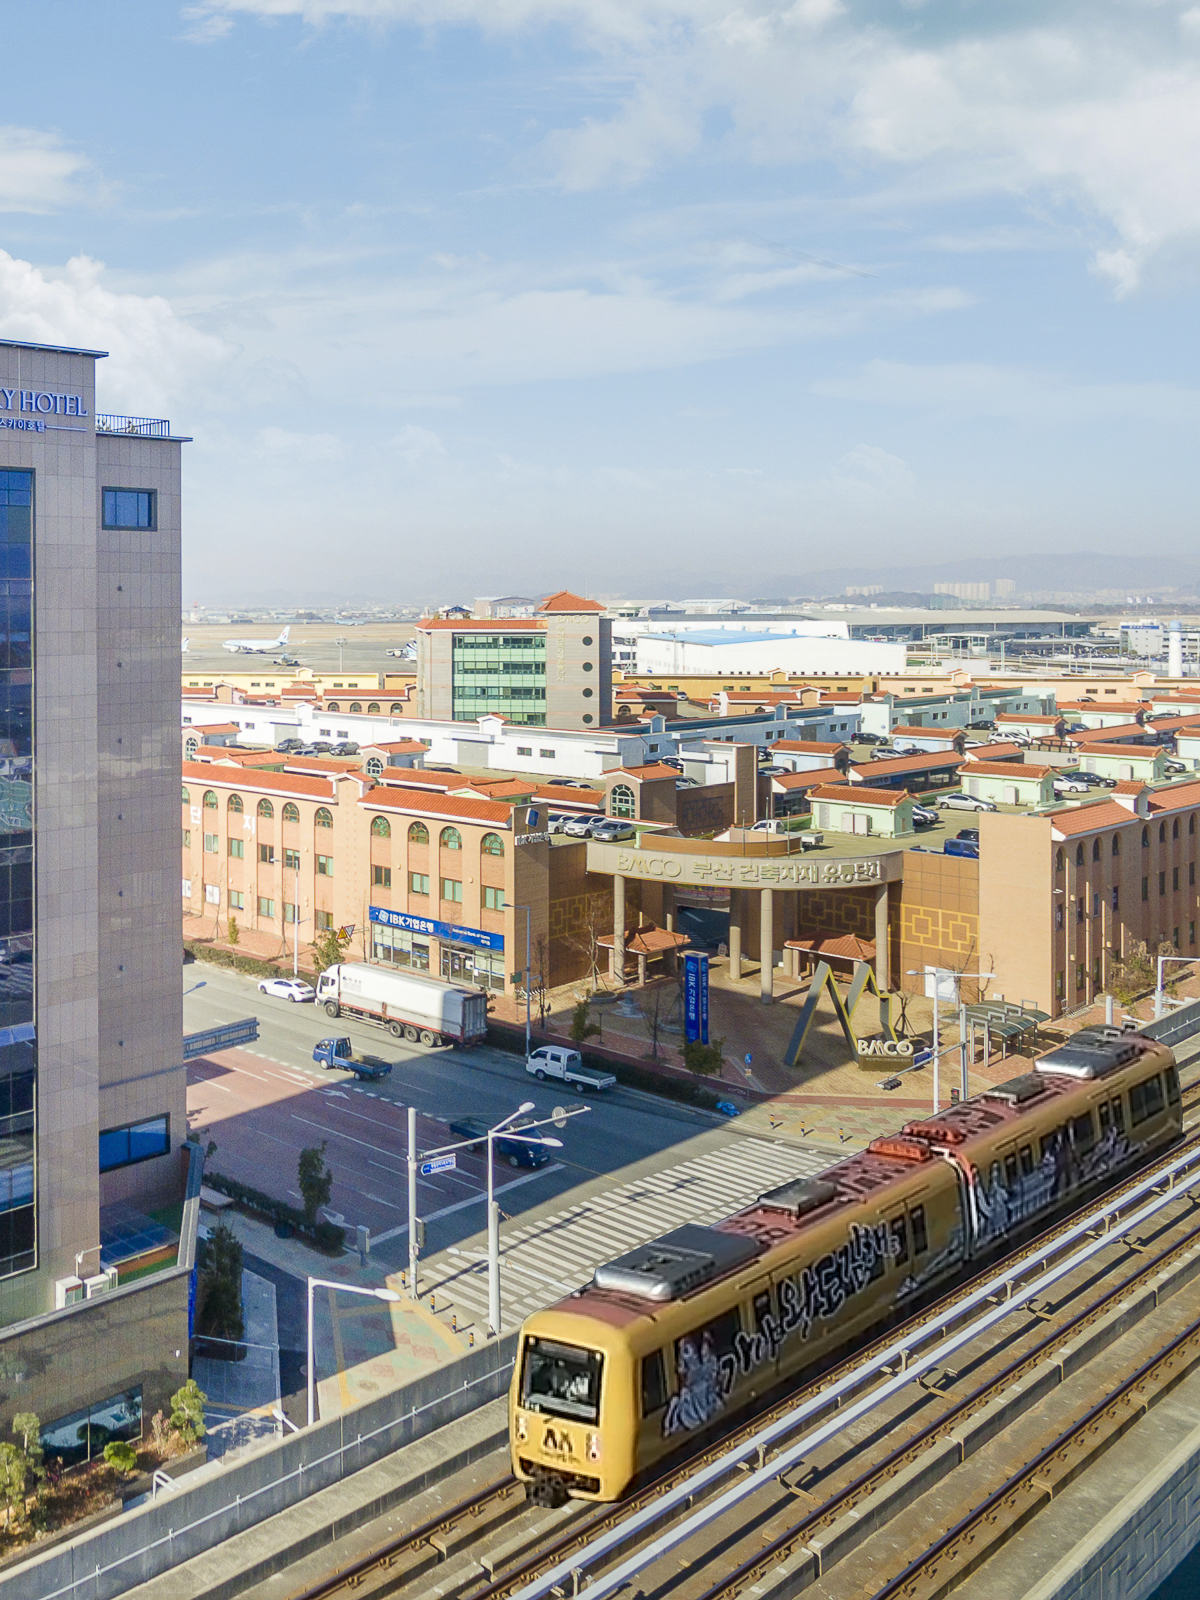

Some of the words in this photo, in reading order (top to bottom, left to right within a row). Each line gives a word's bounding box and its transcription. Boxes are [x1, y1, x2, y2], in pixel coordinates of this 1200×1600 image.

[21, 390, 89, 417] HOTEL
[618, 853, 682, 878] BMCO
[692, 861, 736, 881] 부산
[740, 864, 819, 884] 건축자재
[821, 860, 881, 883] 유통단지
[389, 913, 434, 933] IBK기업은행
[857, 1039, 914, 1056] BMCO
